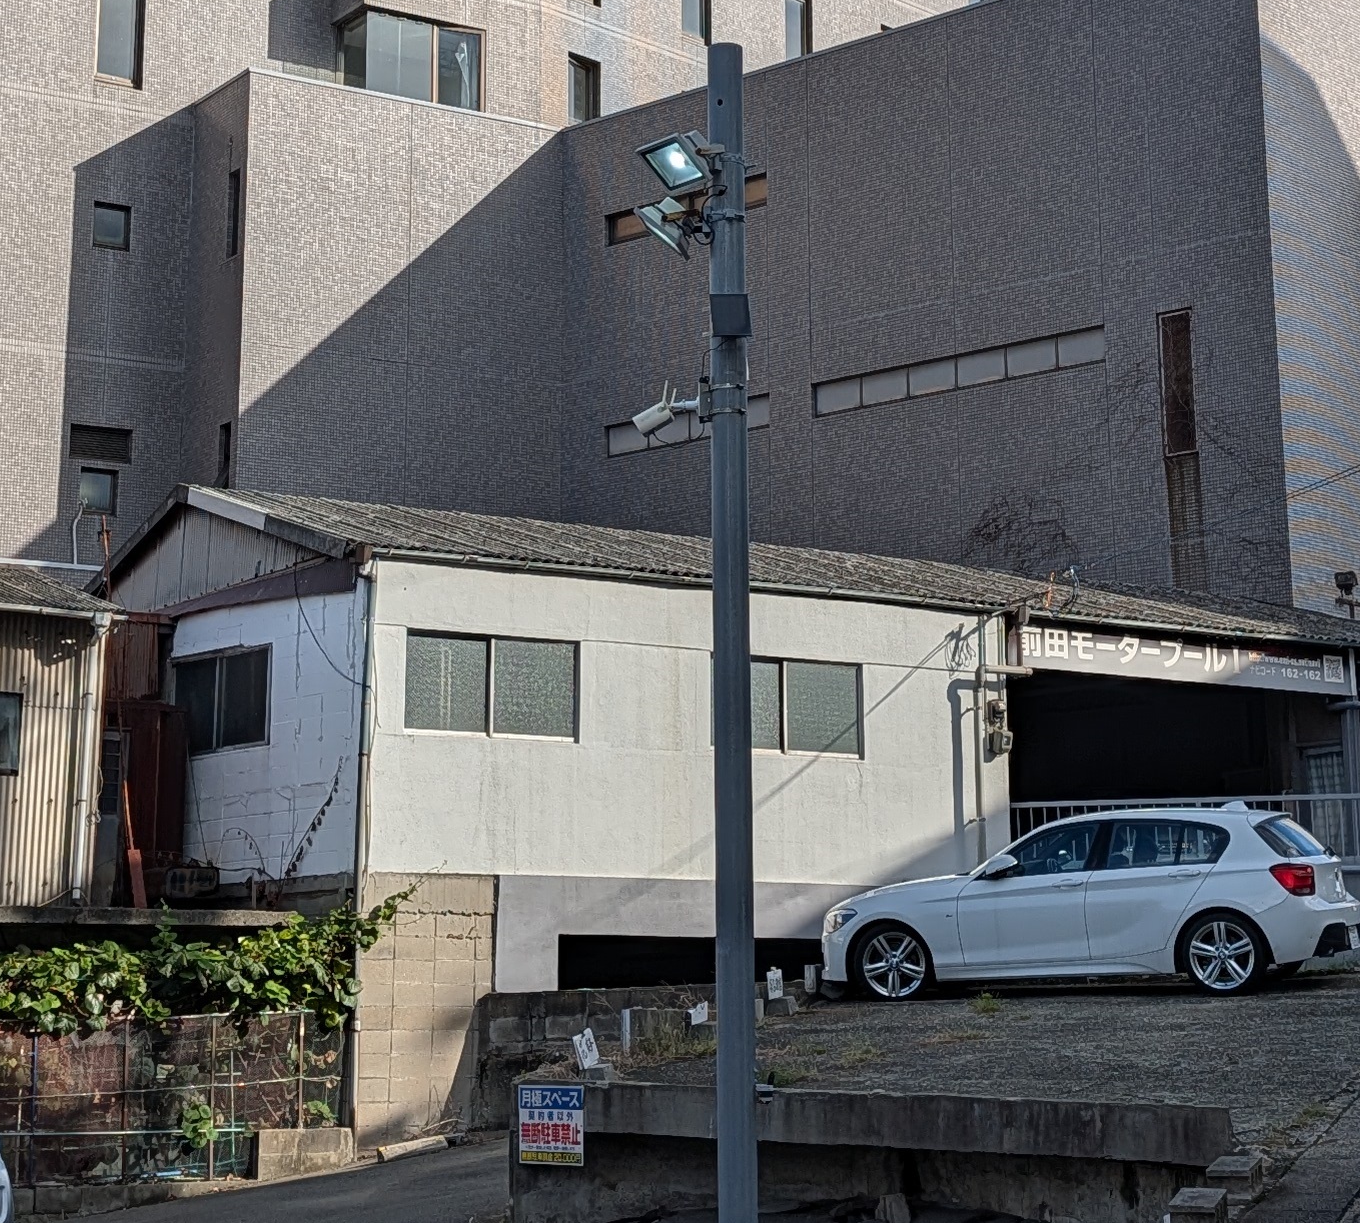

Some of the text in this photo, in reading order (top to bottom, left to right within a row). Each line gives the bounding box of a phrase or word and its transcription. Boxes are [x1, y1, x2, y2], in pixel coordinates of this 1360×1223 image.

[1280, 668, 1321, 681] 162-162
[521, 1090, 580, 1108] 月極スペース
[528, 1110, 574, 1122] 契約者以外
[521, 1122, 582, 1146] 無断駐車禁止
